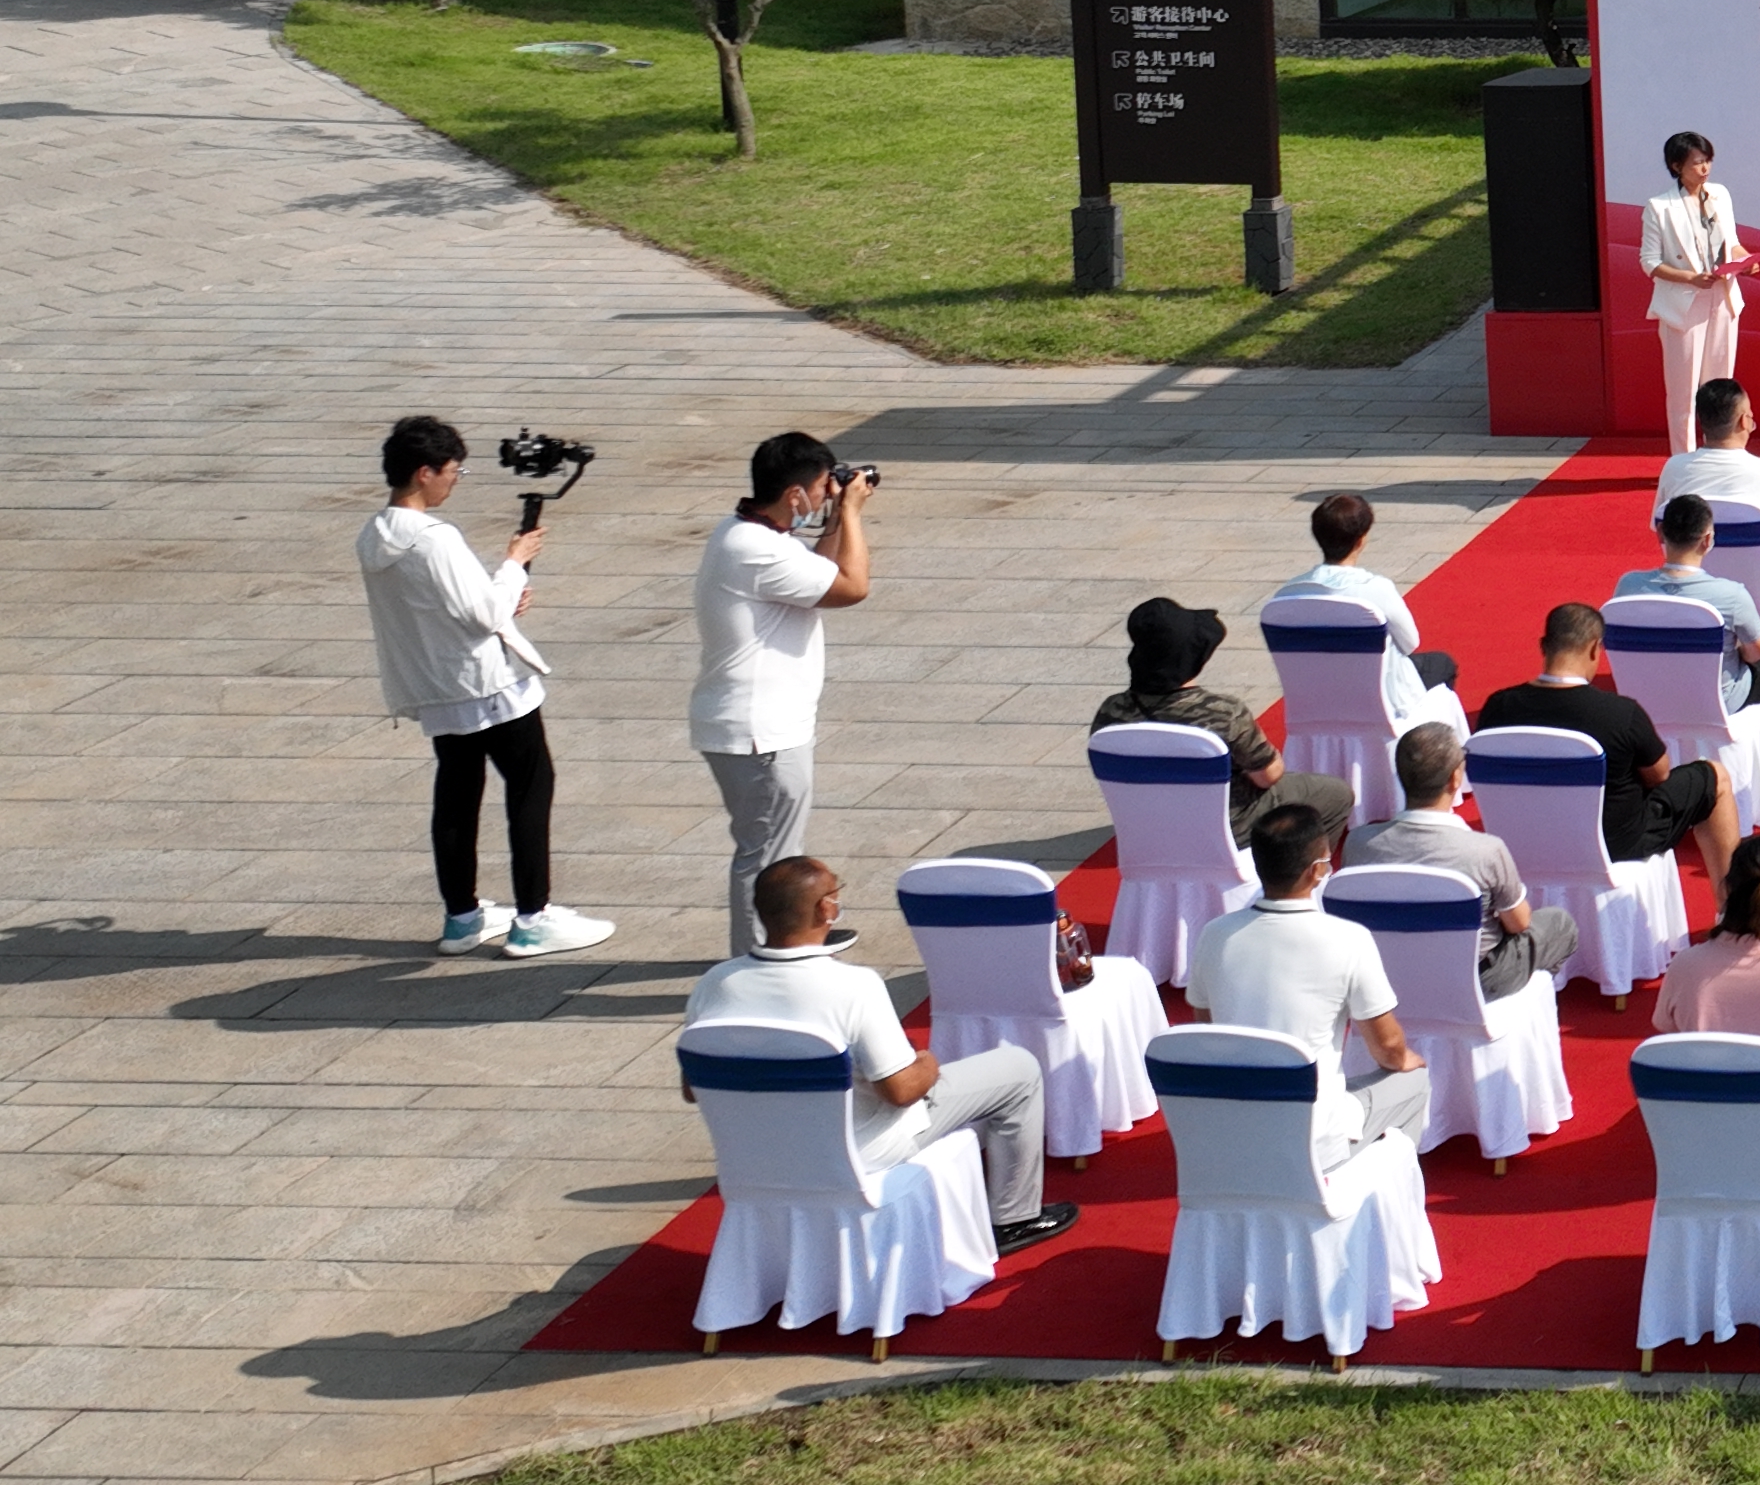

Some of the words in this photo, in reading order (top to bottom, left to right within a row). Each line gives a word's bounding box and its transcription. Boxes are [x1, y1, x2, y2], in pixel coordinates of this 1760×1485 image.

[1131, 5, 1230, 23] 游客接待中心
[1135, 51, 1215, 68] 公共卫生间
[1135, 92, 1185, 110] 停车场
